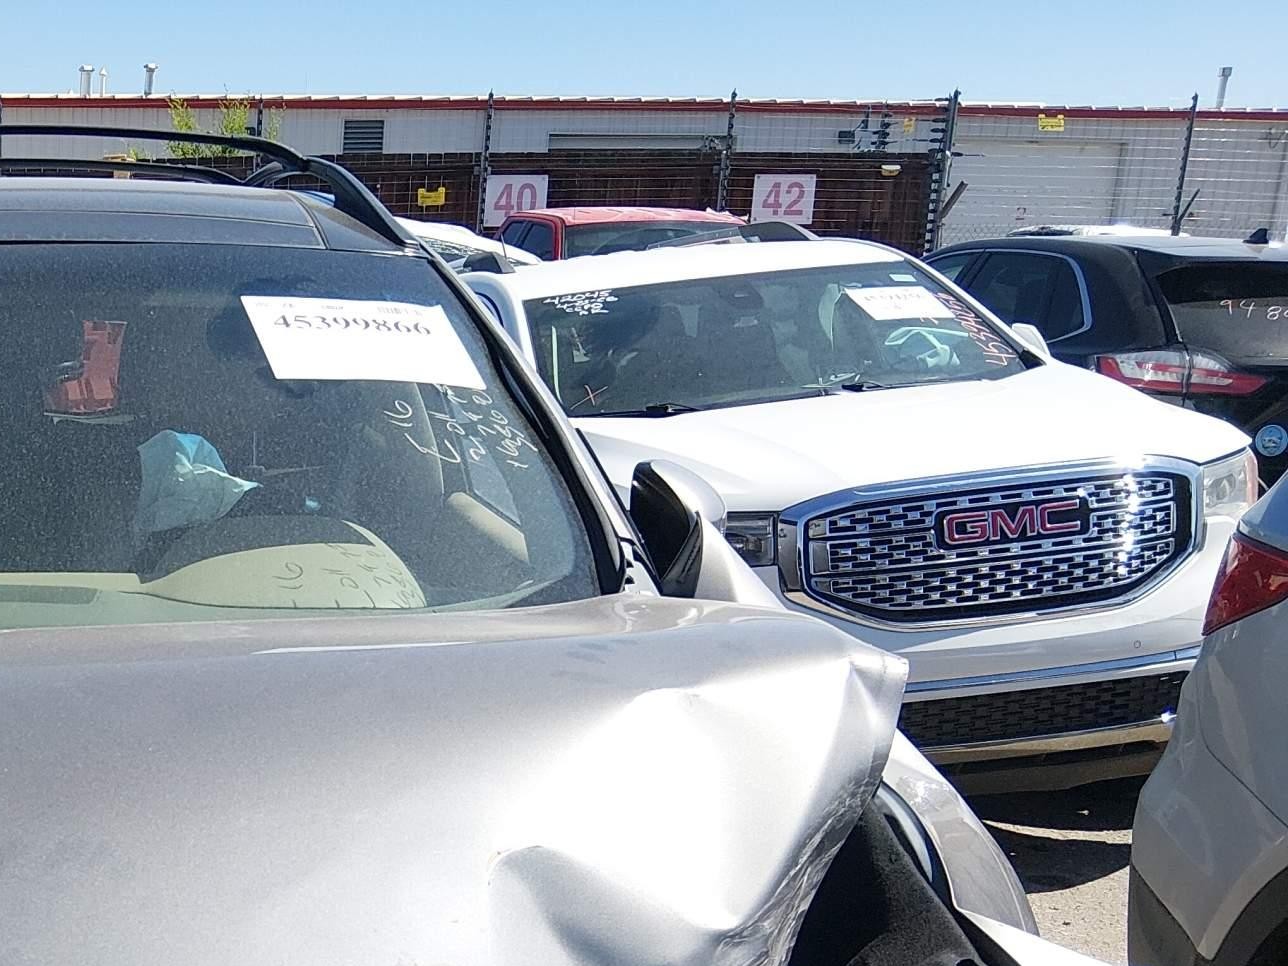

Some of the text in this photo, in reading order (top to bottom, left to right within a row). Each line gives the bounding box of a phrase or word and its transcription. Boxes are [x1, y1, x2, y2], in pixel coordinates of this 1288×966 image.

[493, 183, 537, 217] 40
[762, 181, 805, 216] 42
[273, 314, 432, 335] 45399866
[943, 499, 1081, 546] GMC
